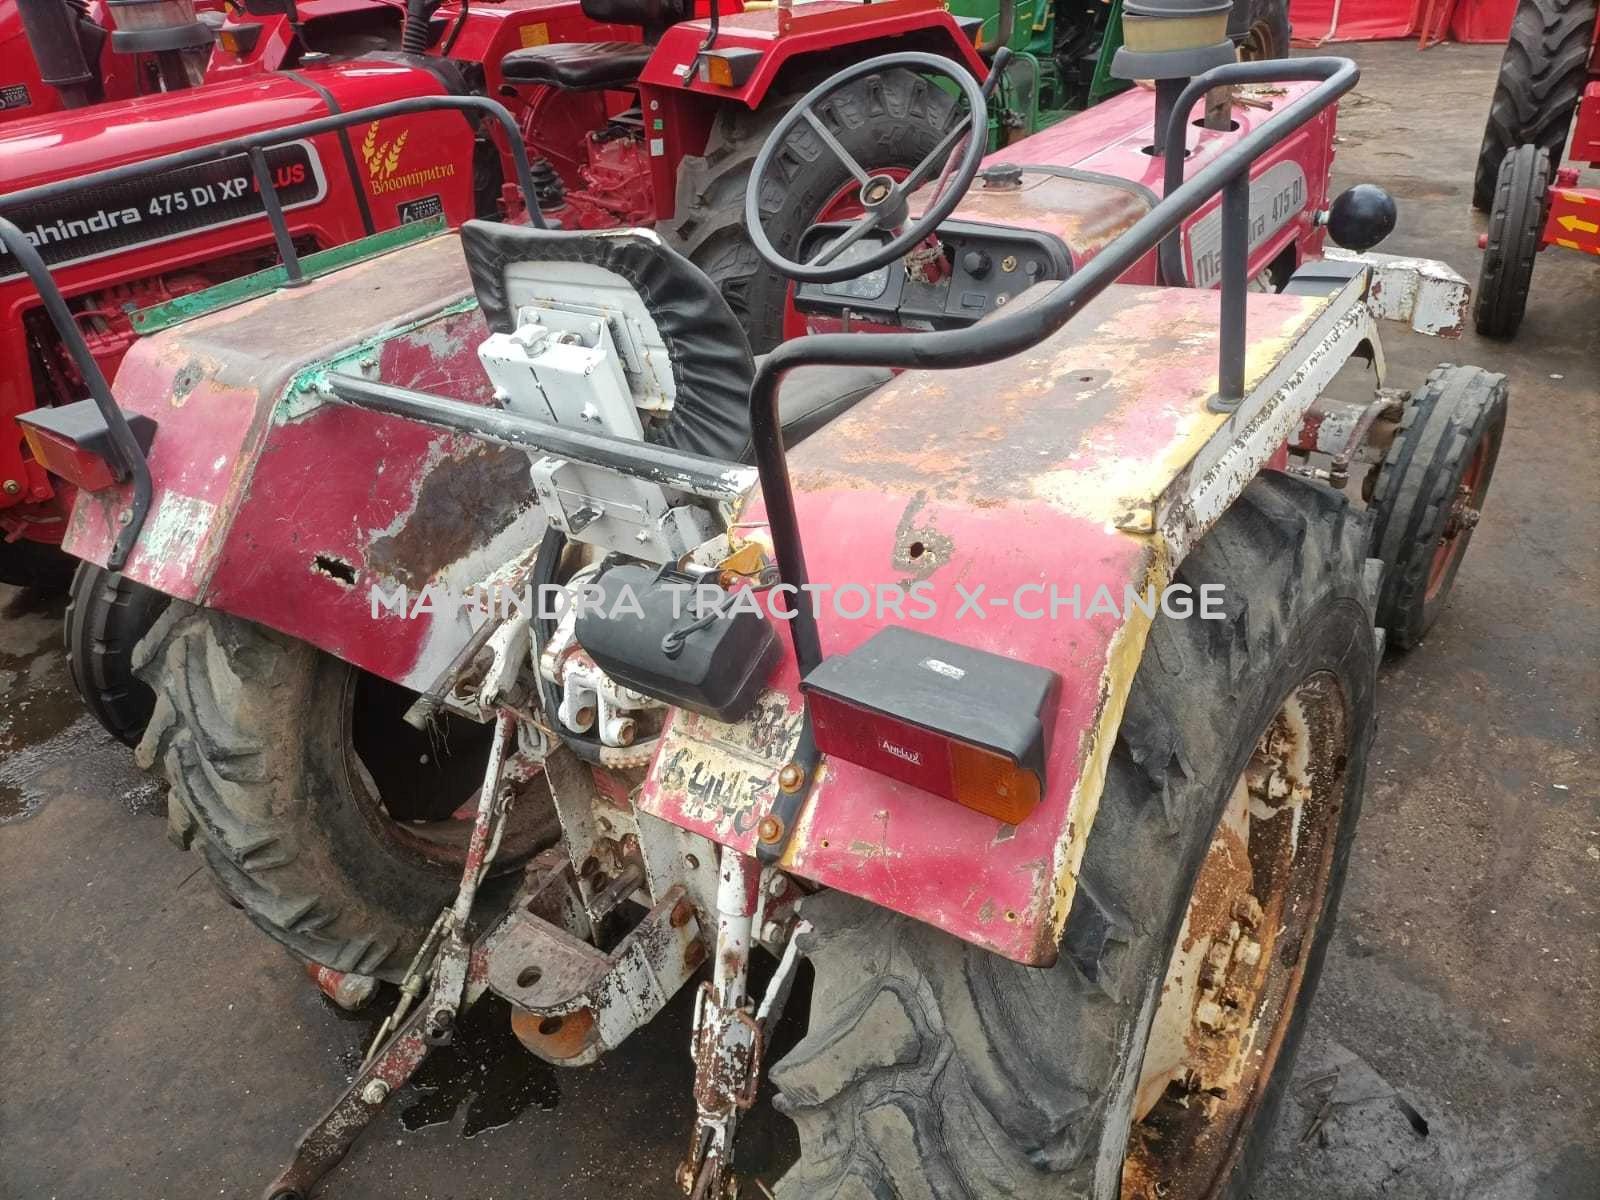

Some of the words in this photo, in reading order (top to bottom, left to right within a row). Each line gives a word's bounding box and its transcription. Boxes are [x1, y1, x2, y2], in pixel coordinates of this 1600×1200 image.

[371, 163, 455, 196] Bhoomiputra
[1272, 187, 1290, 222] 475
[1292, 175, 1302, 205] DI
[0, 207, 142, 254] ahindra
[149, 192, 188, 216] 475
[190, 185, 217, 207] DI
[217, 177, 249, 201] XP
[402, 207, 414, 224] 6
